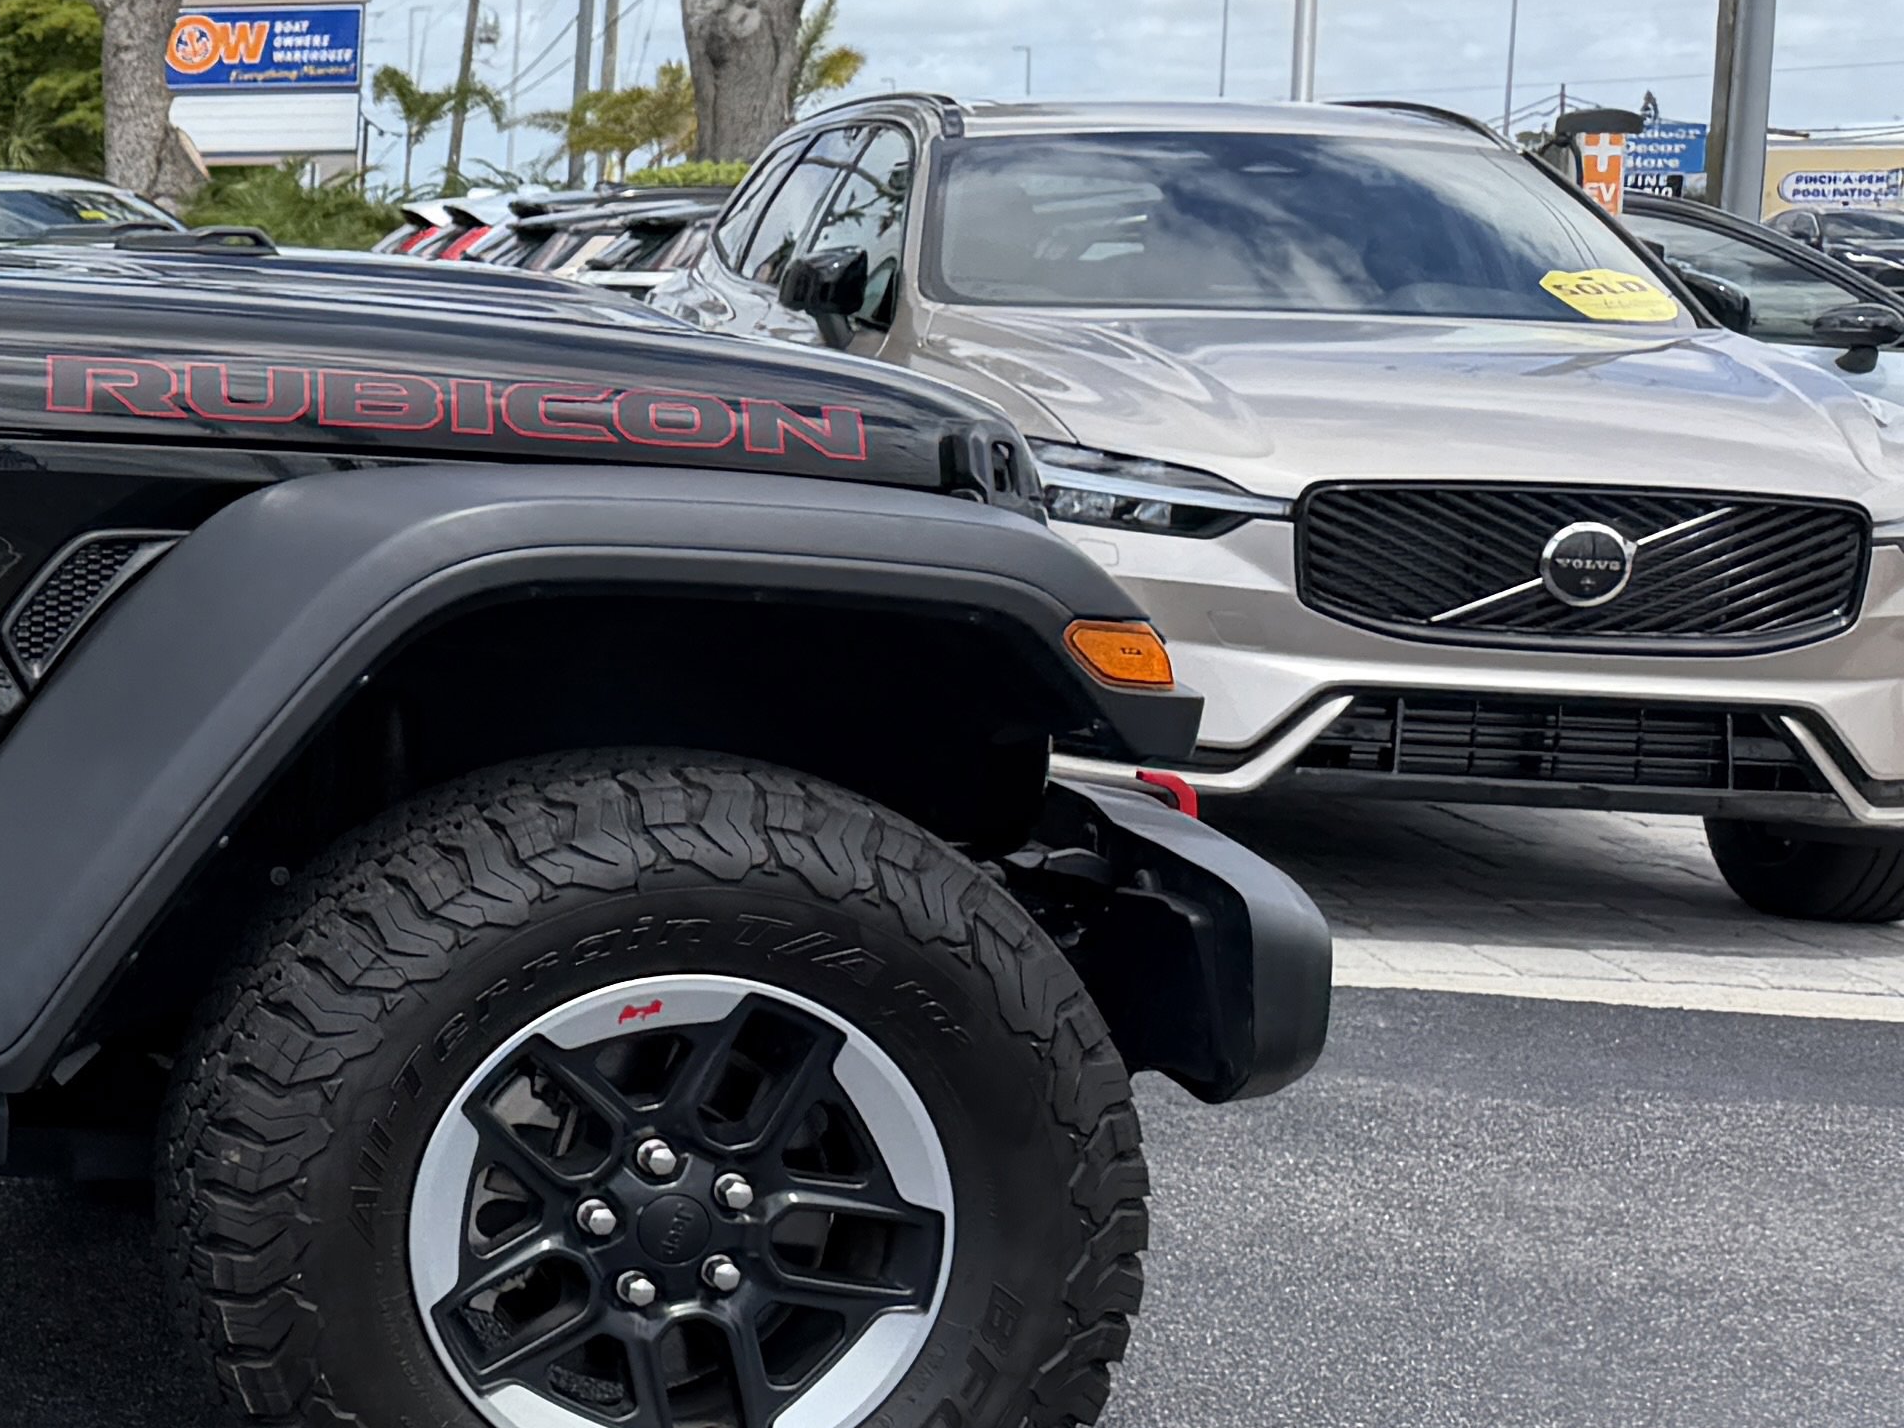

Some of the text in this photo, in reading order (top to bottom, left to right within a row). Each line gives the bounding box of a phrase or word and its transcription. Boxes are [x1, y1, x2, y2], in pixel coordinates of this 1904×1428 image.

[273, 20, 310, 33] BOAT
[272, 34, 331, 48] OWNERS
[272, 48, 354, 63] WAREHOUSE
[1551, 280, 1648, 296] SOLD
[45, 354, 869, 461] RUBICON
[1554, 557, 1622, 571] VOLVO
[659, 1201, 695, 1256] Jeep
